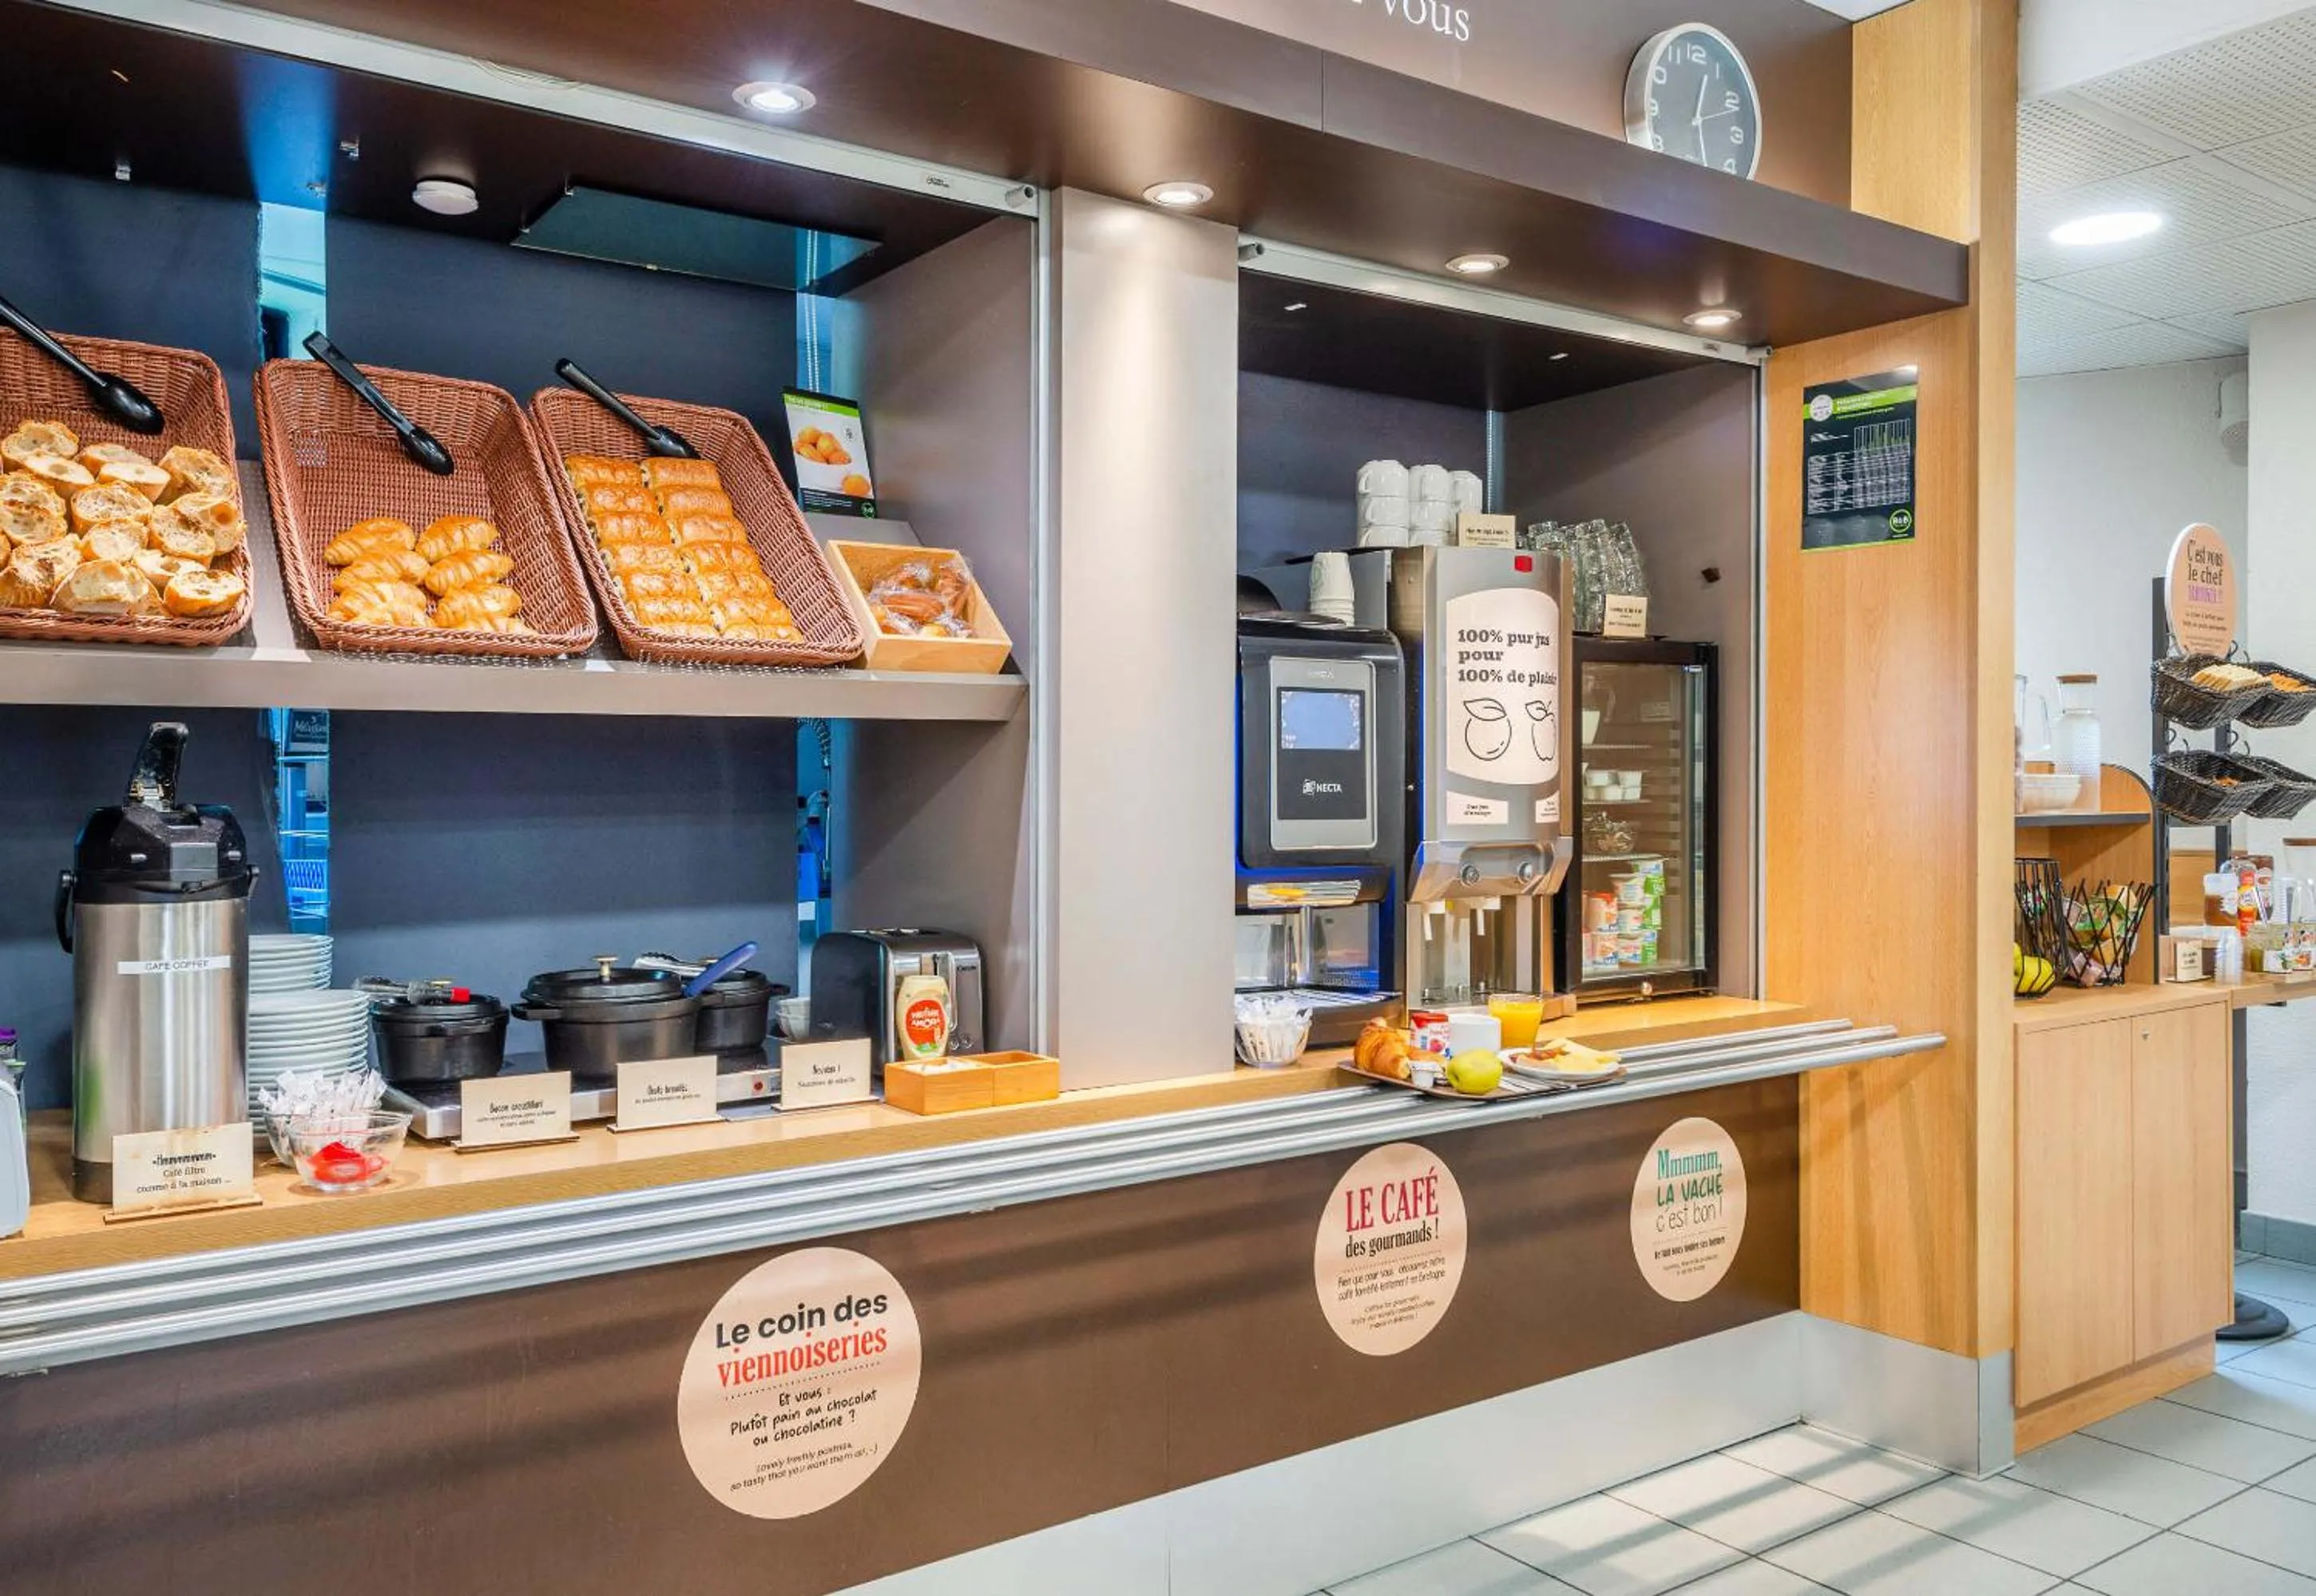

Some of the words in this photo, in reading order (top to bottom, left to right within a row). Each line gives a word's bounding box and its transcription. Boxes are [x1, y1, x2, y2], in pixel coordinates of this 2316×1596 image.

[1687, 42, 1707, 65] 12
[1725, 90, 1740, 111] 2
[1729, 126, 1744, 145] 3
[2188, 563, 2198, 581] le
[2200, 566, 2223, 585] chef
[1458, 629, 1503, 643] 100%
[1507, 633, 1533, 647] pur
[1534, 632, 1549, 648] jus
[1458, 651, 1504, 664] pour
[1458, 669, 1503, 683] 100%
[1507, 670, 1525, 683] de
[1316, 783, 1342, 793] NECTA
[1346, 1187, 1374, 1232] LE
[1381, 1166, 1439, 1224] CAFÉ
[1657, 1183, 1674, 1206] LA
[1680, 1173, 1723, 1202] VACHE
[1346, 1235, 1366, 1257] des
[1369, 1220, 1432, 1257] gourmands
[716, 1322, 750, 1348] Le
[759, 1303, 826, 1338] coin
[834, 1294, 887, 1322] des
[716, 1321, 887, 1388] viennoiseries
[779, 1392, 791, 1406] Et
[795, 1388, 822, 1402] vous
[730, 1413, 767, 1436] Plutôt
[773, 1409, 800, 1430] pain
[806, 1405, 822, 1416] au
[827, 1389, 877, 1412] chocolat
[753, 1436, 767, 1447] ou
[774, 1416, 843, 1441] chocolatine
